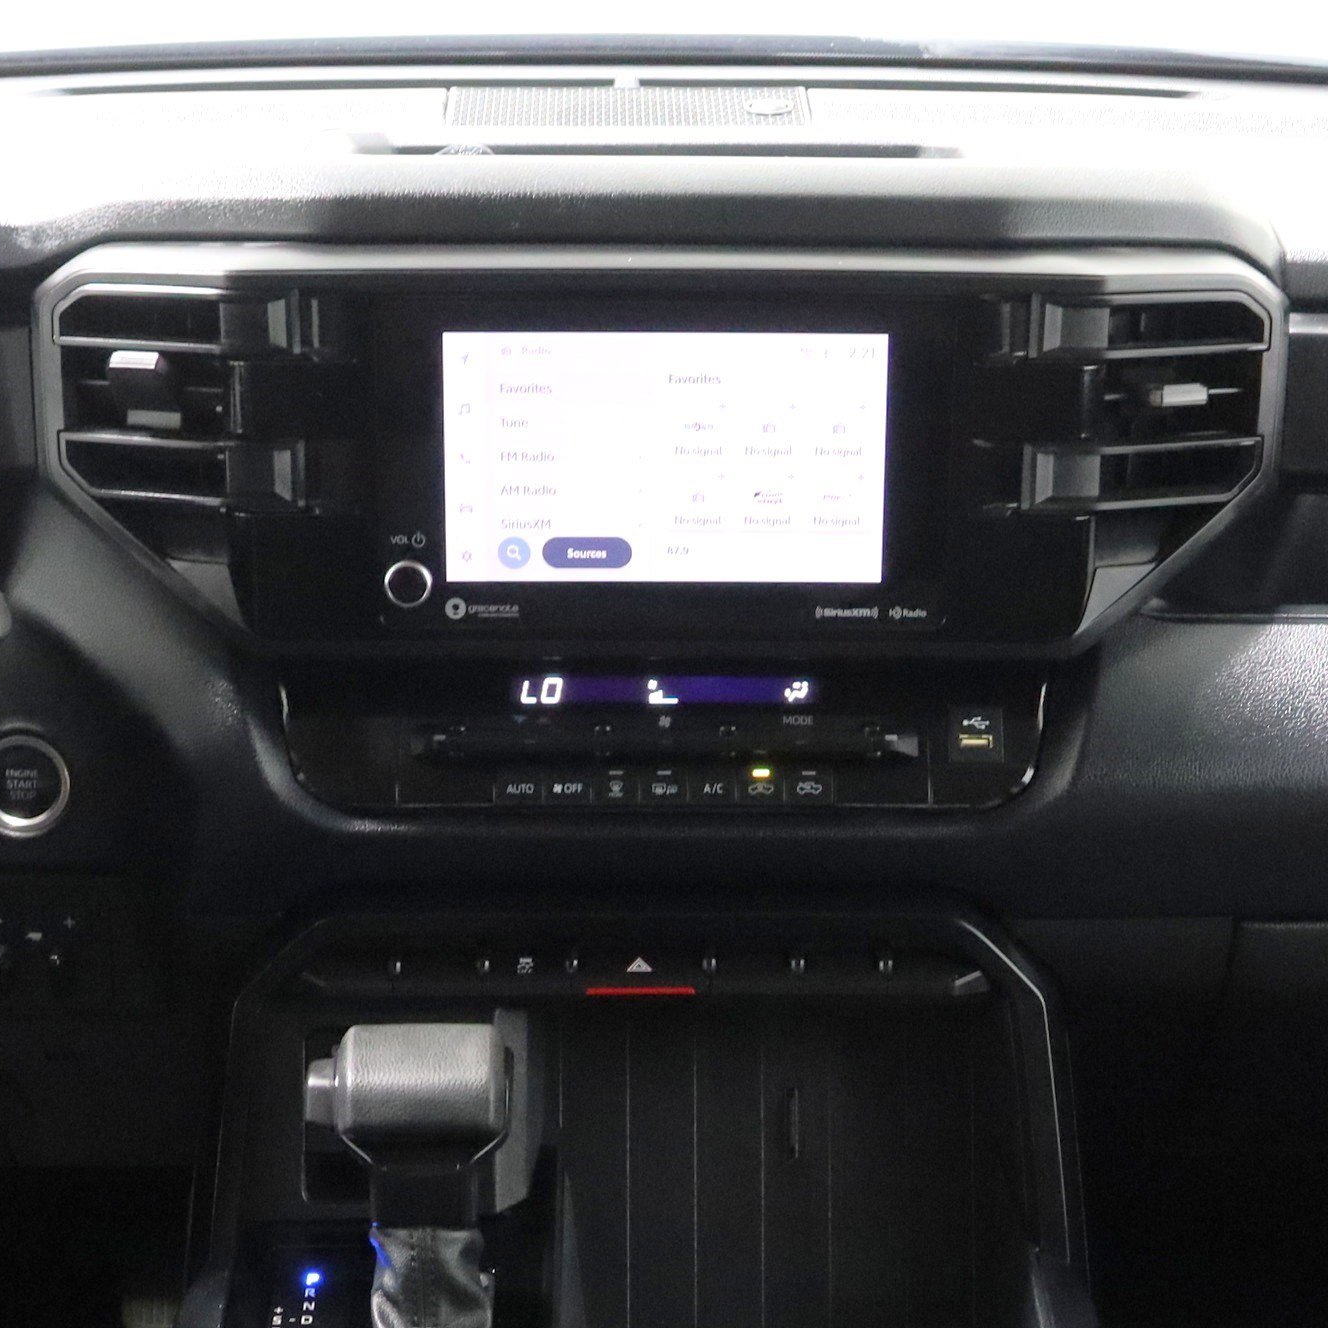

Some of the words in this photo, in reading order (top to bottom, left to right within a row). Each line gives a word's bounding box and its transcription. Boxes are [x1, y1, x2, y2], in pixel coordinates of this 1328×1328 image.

[669, 373, 722, 386] Favorites
[499, 382, 553, 395] Favorites
[500, 416, 529, 429] Tune
[500, 451, 518, 463] FM
[521, 450, 555, 463] Radio
[500, 485, 520, 497] AM
[522, 484, 558, 497] Radio
[500, 518, 552, 530] SiriusXM
[390, 534, 410, 545] VOL
[567, 547, 607, 560] Sources
[520, 676, 564, 704] LO
[782, 715, 814, 726] MODE
[6, 779, 38, 789] START
[506, 783, 535, 795] AUTO
[563, 783, 584, 795] OFF
[703, 783, 724, 795] A/C
[305, 1272, 321, 1286] P
[304, 1287, 316, 1298] R
[302, 1301, 316, 1311] N
[300, 1315, 314, 1325] D
